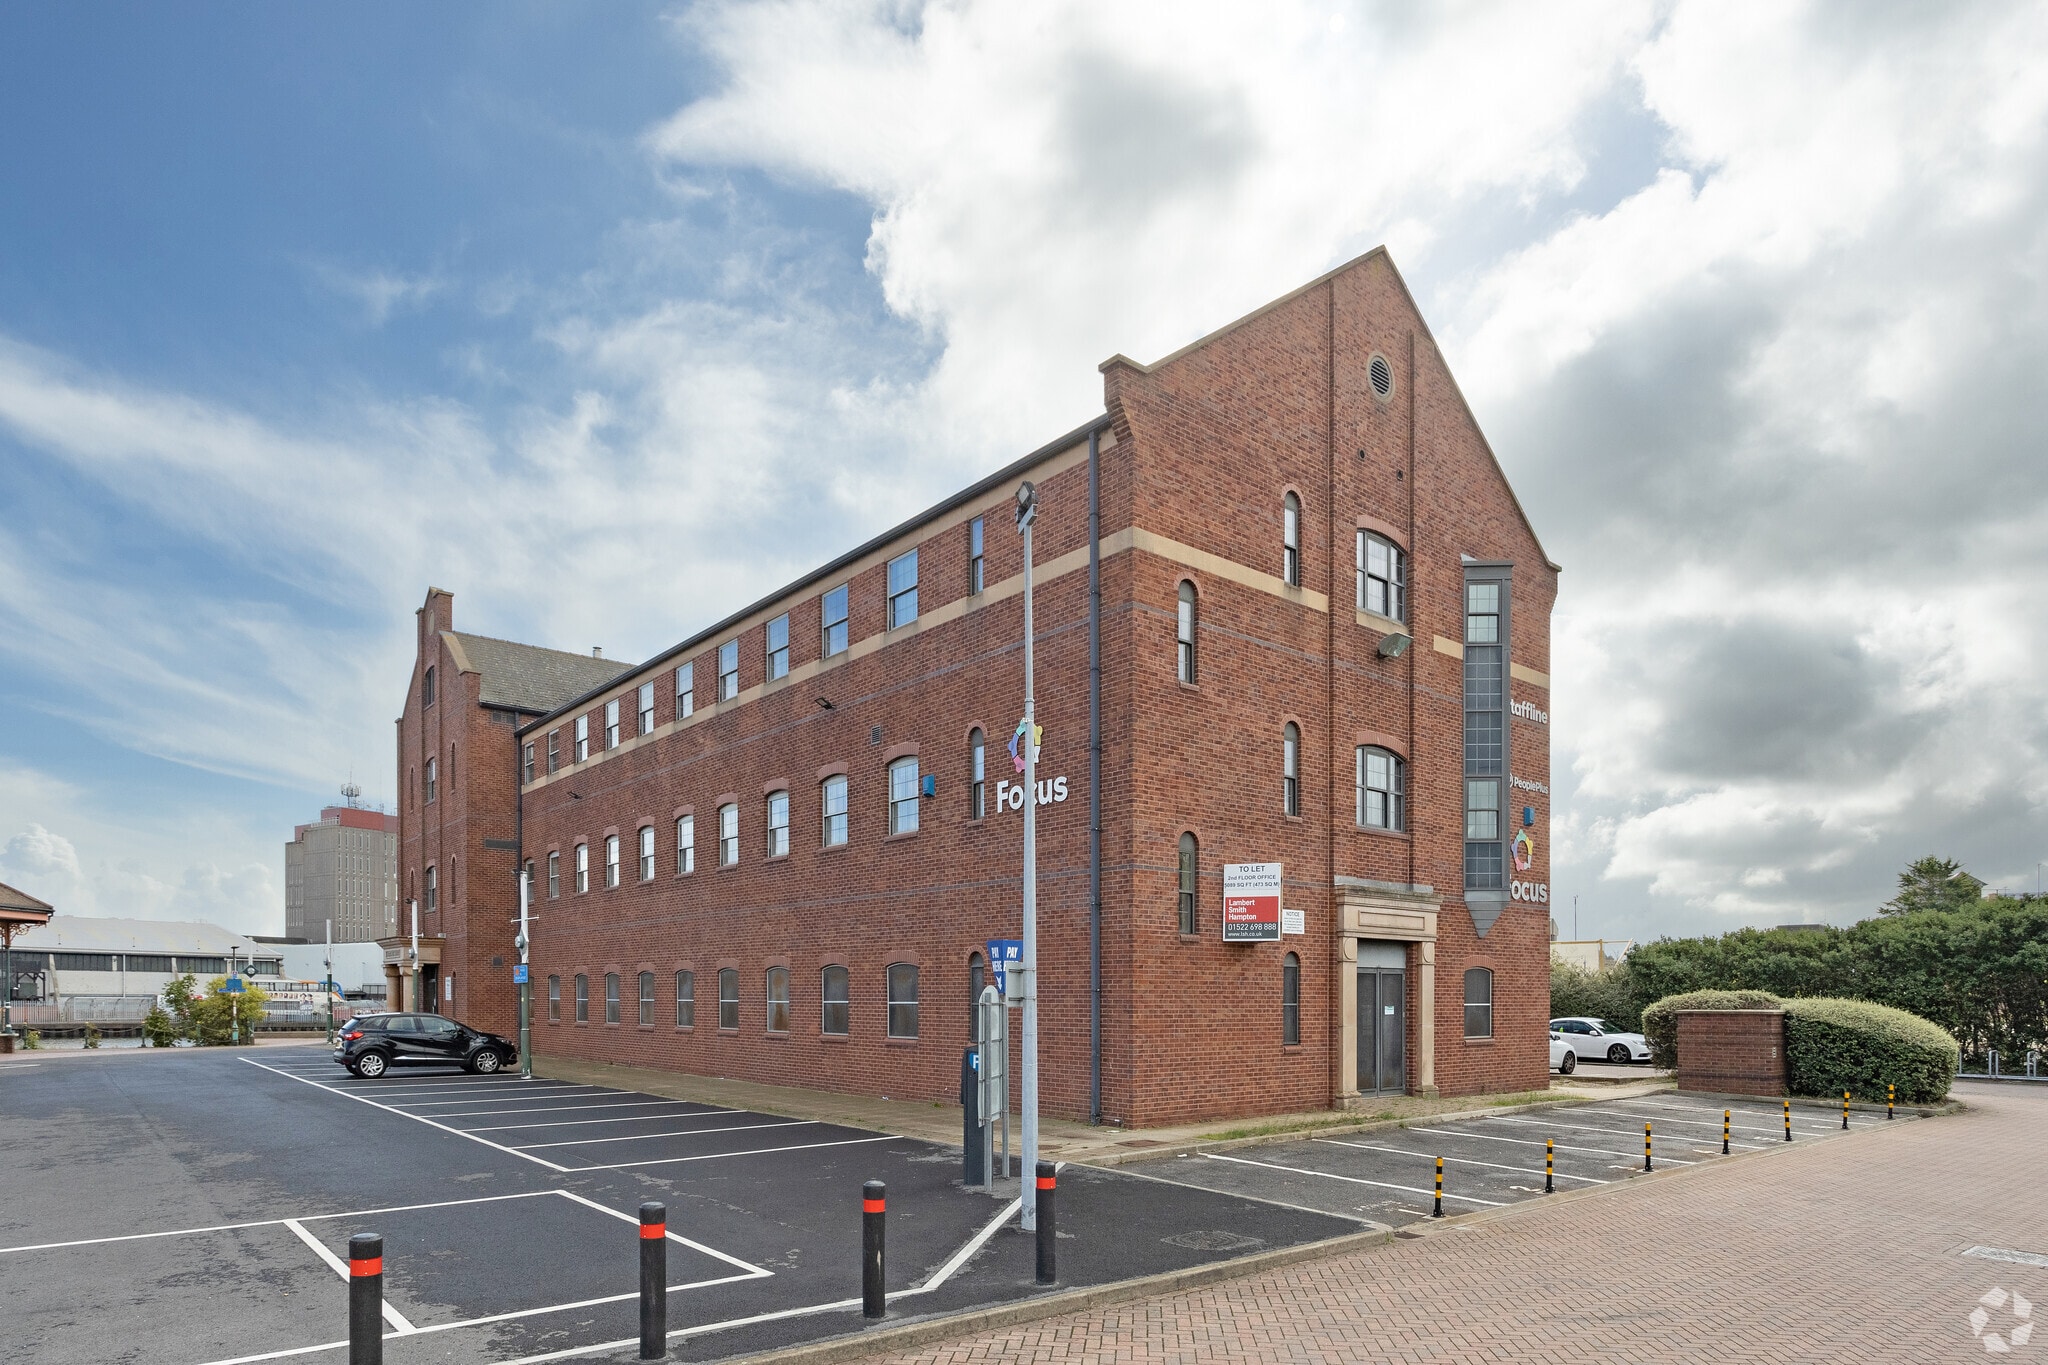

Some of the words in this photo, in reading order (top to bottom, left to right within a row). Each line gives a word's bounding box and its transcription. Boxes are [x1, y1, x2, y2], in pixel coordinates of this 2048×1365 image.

[997, 776, 1068, 813] Fous
[1514, 777, 1548, 794] PeoplePlus
[1510, 875, 1547, 903] ocus
[1006, 947, 1019, 959] PAY
